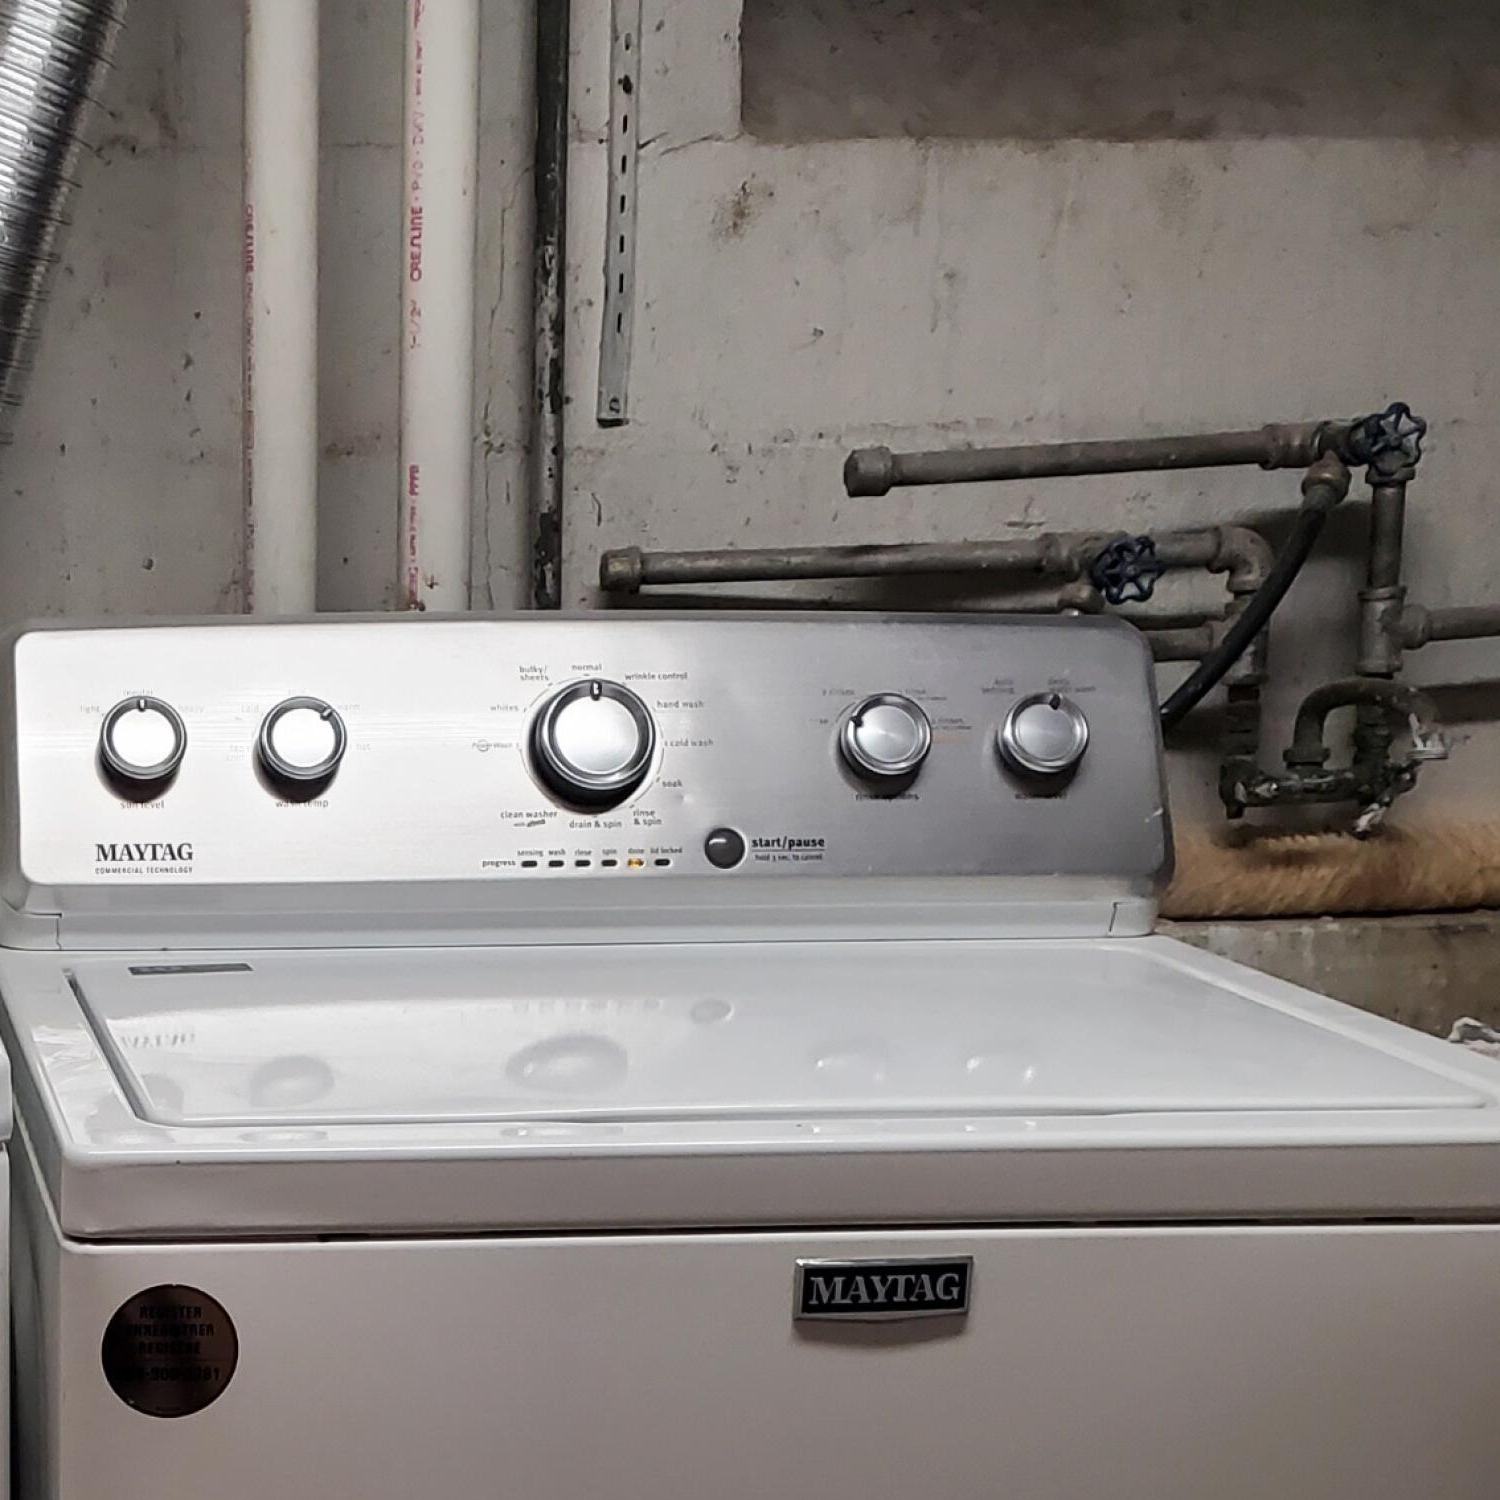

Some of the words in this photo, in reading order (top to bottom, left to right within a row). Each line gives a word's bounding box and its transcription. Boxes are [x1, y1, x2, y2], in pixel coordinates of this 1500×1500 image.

[571, 663, 602, 671] normal
[625, 672, 656, 681] wrinkle
[657, 672, 688, 680] control
[656, 700, 679, 709] hand
[682, 700, 704, 709] wash
[670, 738, 689, 747] cold
[691, 738, 714, 747] wash
[662, 779, 683, 788] soak
[500, 810, 524, 819] clean
[526, 810, 558, 819] washer
[633, 809, 655, 817] rinse
[569, 820, 592, 829] drain
[594, 820, 601, 828] &
[603, 819, 622, 830] spin
[643, 817, 662, 827] spin
[752, 835, 825, 851] start/pause
[95, 842, 193, 862] MAYTAG
[95, 866, 144, 875] COMMERCIAL
[146, 866, 193, 874] TECHNOLOGY
[808, 1273, 962, 1305] MAYTAG
